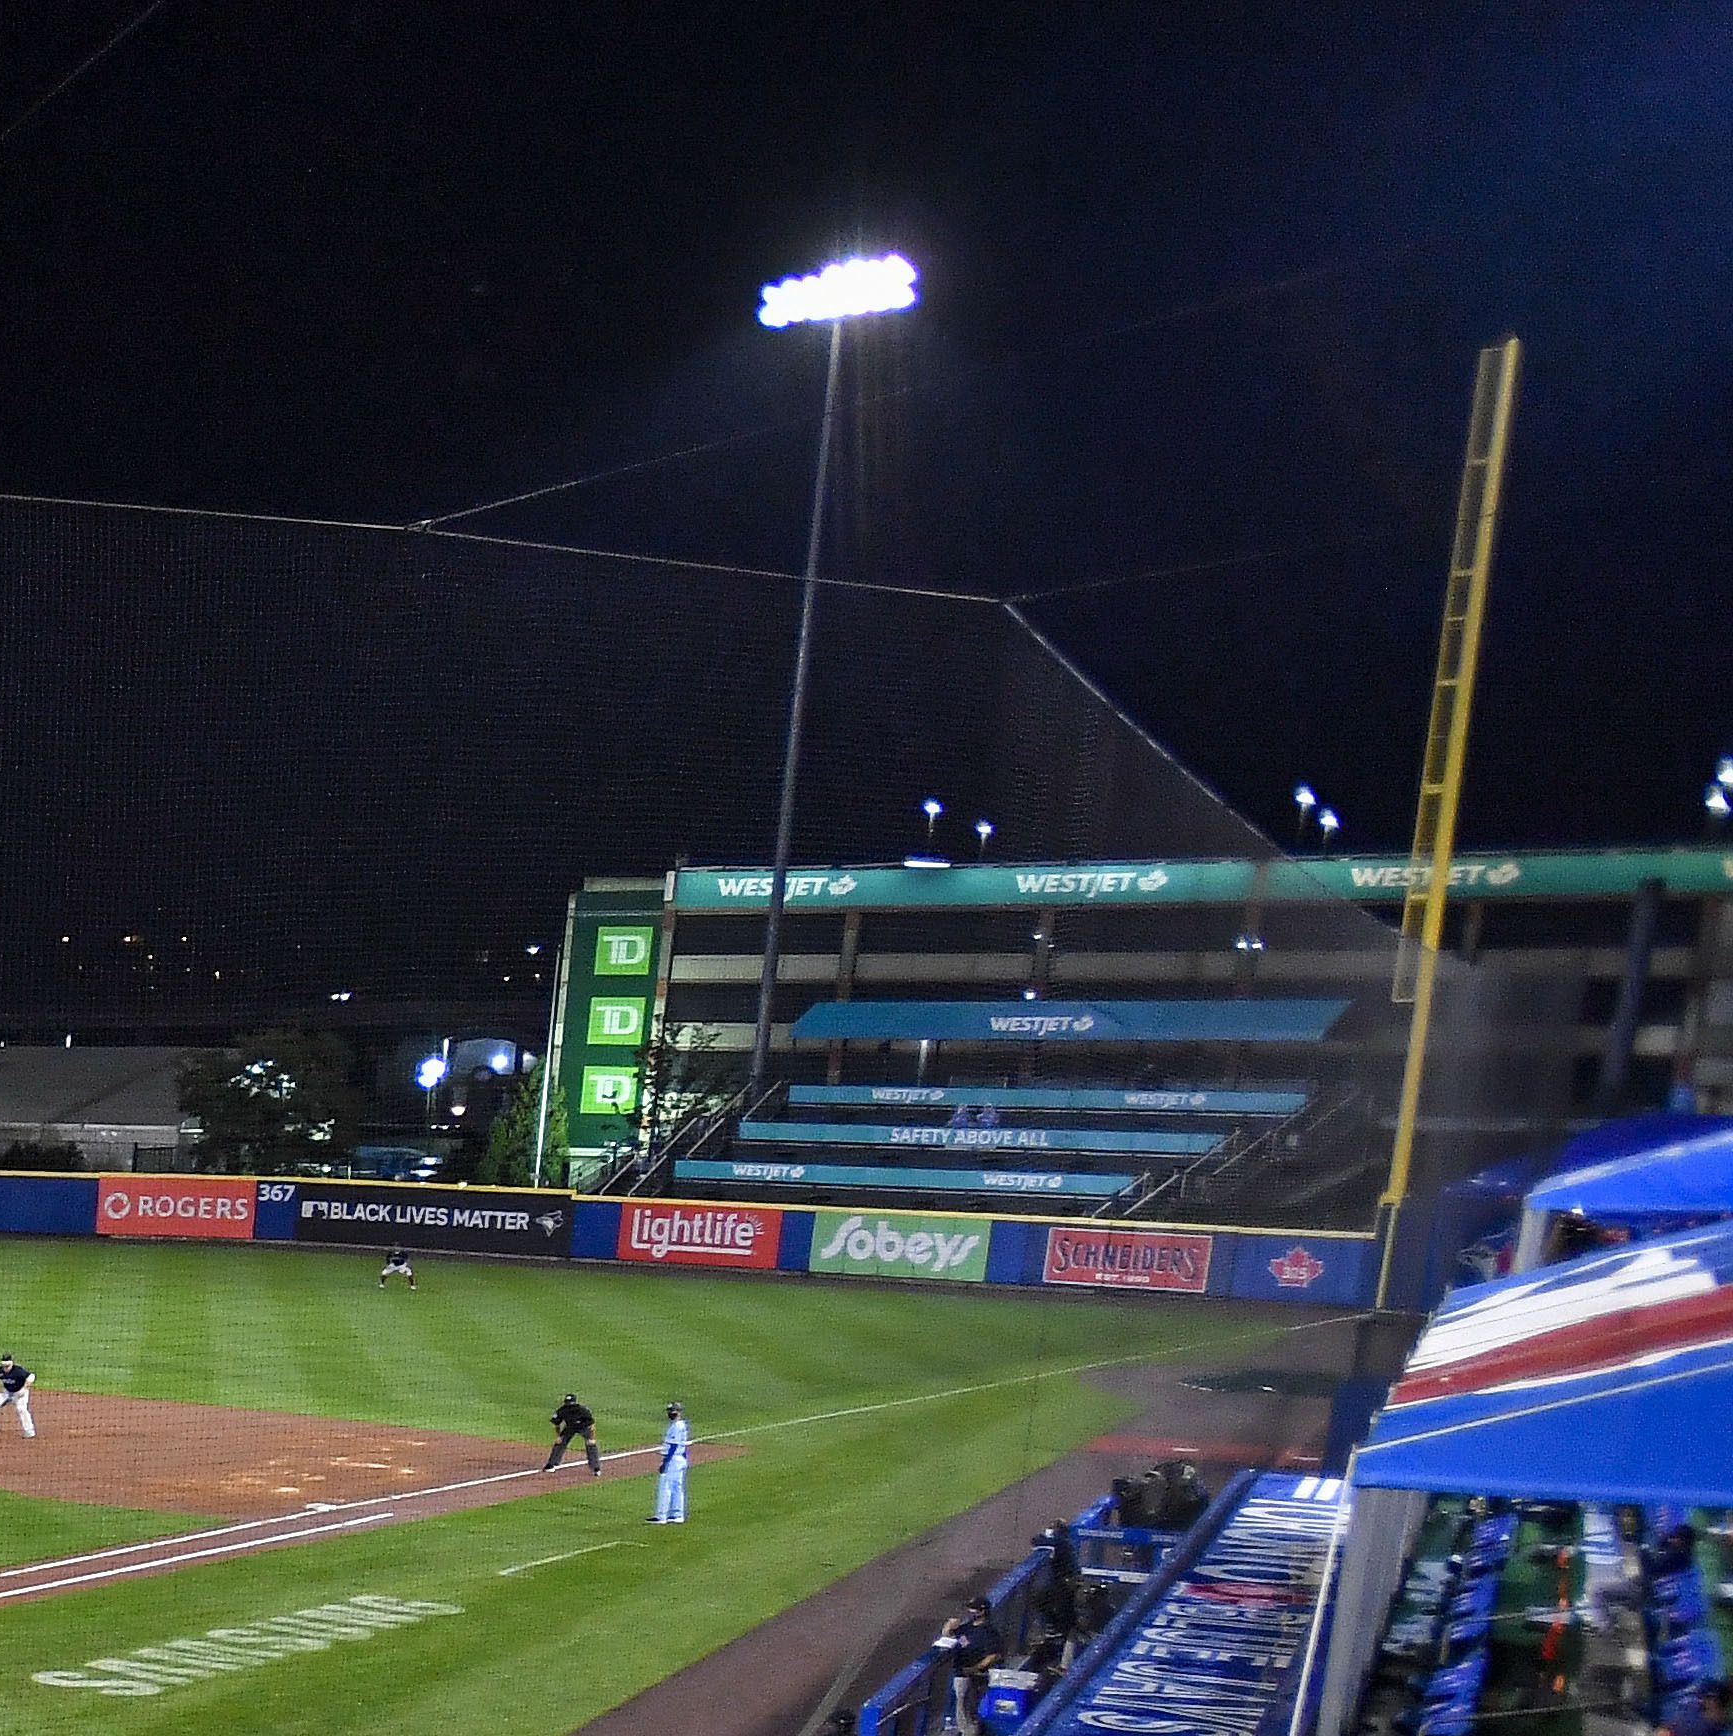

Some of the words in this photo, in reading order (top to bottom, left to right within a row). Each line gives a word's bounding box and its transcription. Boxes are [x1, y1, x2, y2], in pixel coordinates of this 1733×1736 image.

[1016, 872, 1137, 898] WESTJET
[1351, 864, 1486, 887] WESTET
[718, 876, 828, 902] WESJET
[602, 935, 646, 965] TD
[596, 1005, 639, 1035] TD
[991, 1015, 1073, 1036] WESTJET
[589, 1074, 631, 1104] TD
[890, 1128, 951, 1144] SAFETY
[953, 1129, 1013, 1145] ABOVE
[1016, 1131, 1049, 1146] ALL
[733, 1164, 790, 1180] WESTJET
[983, 1173, 1048, 1190] WESTJET
[259, 1184, 295, 1203] 367
[138, 1196, 248, 1220] ROGERS
[330, 1203, 393, 1222] BLACK
[395, 1206, 448, 1226] LIVES
[452, 1209, 530, 1231] MATTER
[821, 1215, 980, 1272] Sobeys
